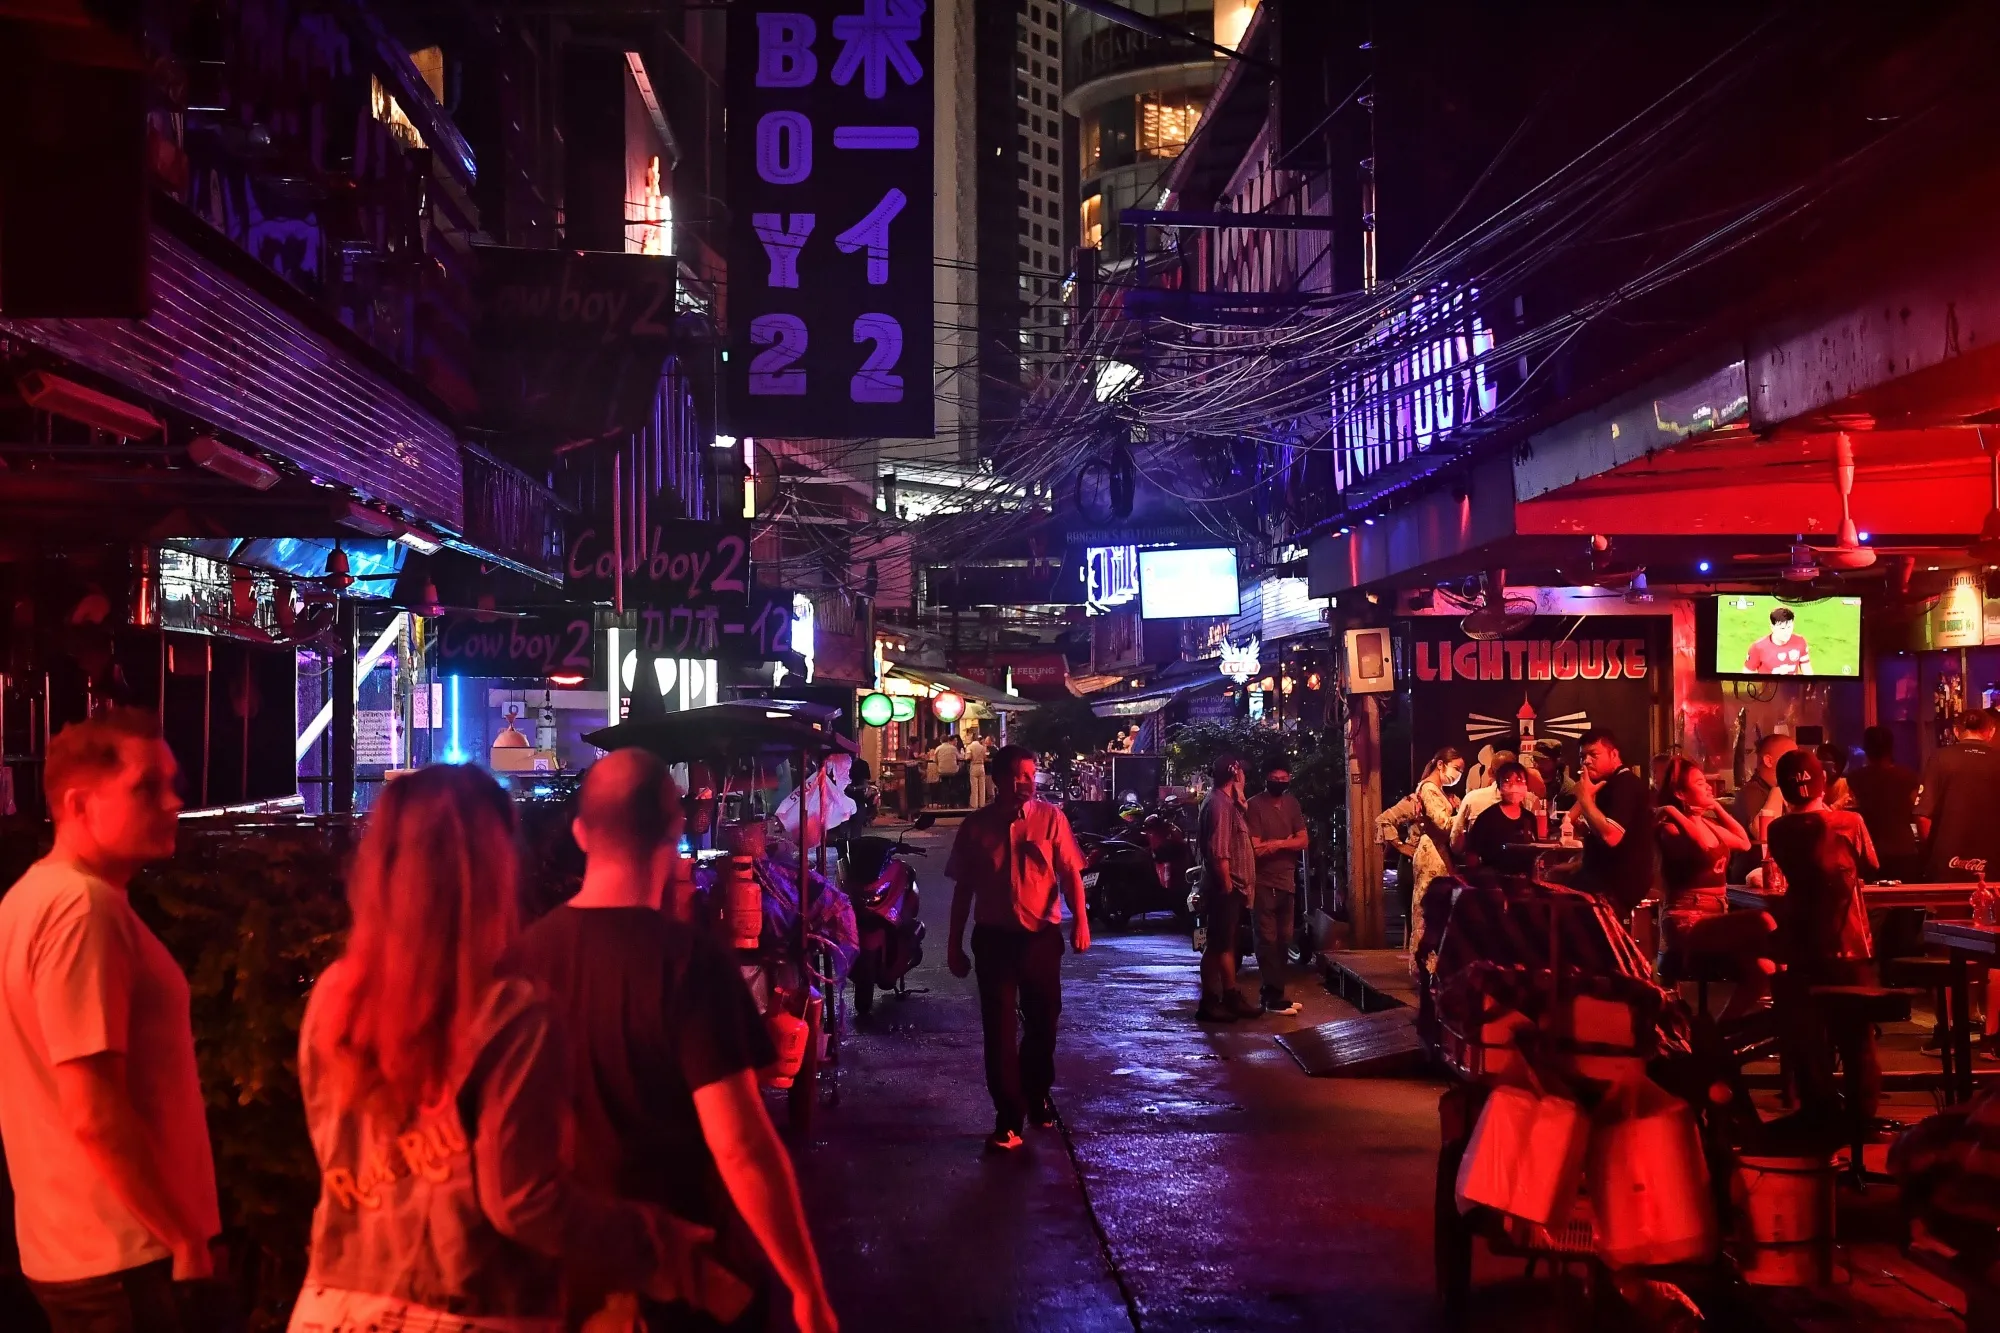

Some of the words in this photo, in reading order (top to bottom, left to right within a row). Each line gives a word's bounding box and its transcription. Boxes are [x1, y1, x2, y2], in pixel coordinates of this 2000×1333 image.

[710, 535, 746, 594] 2
[440, 616, 562, 675] Cowboy
[562, 619, 591, 668] 2
[1416, 640, 1648, 682] LIGHTHOUSE
